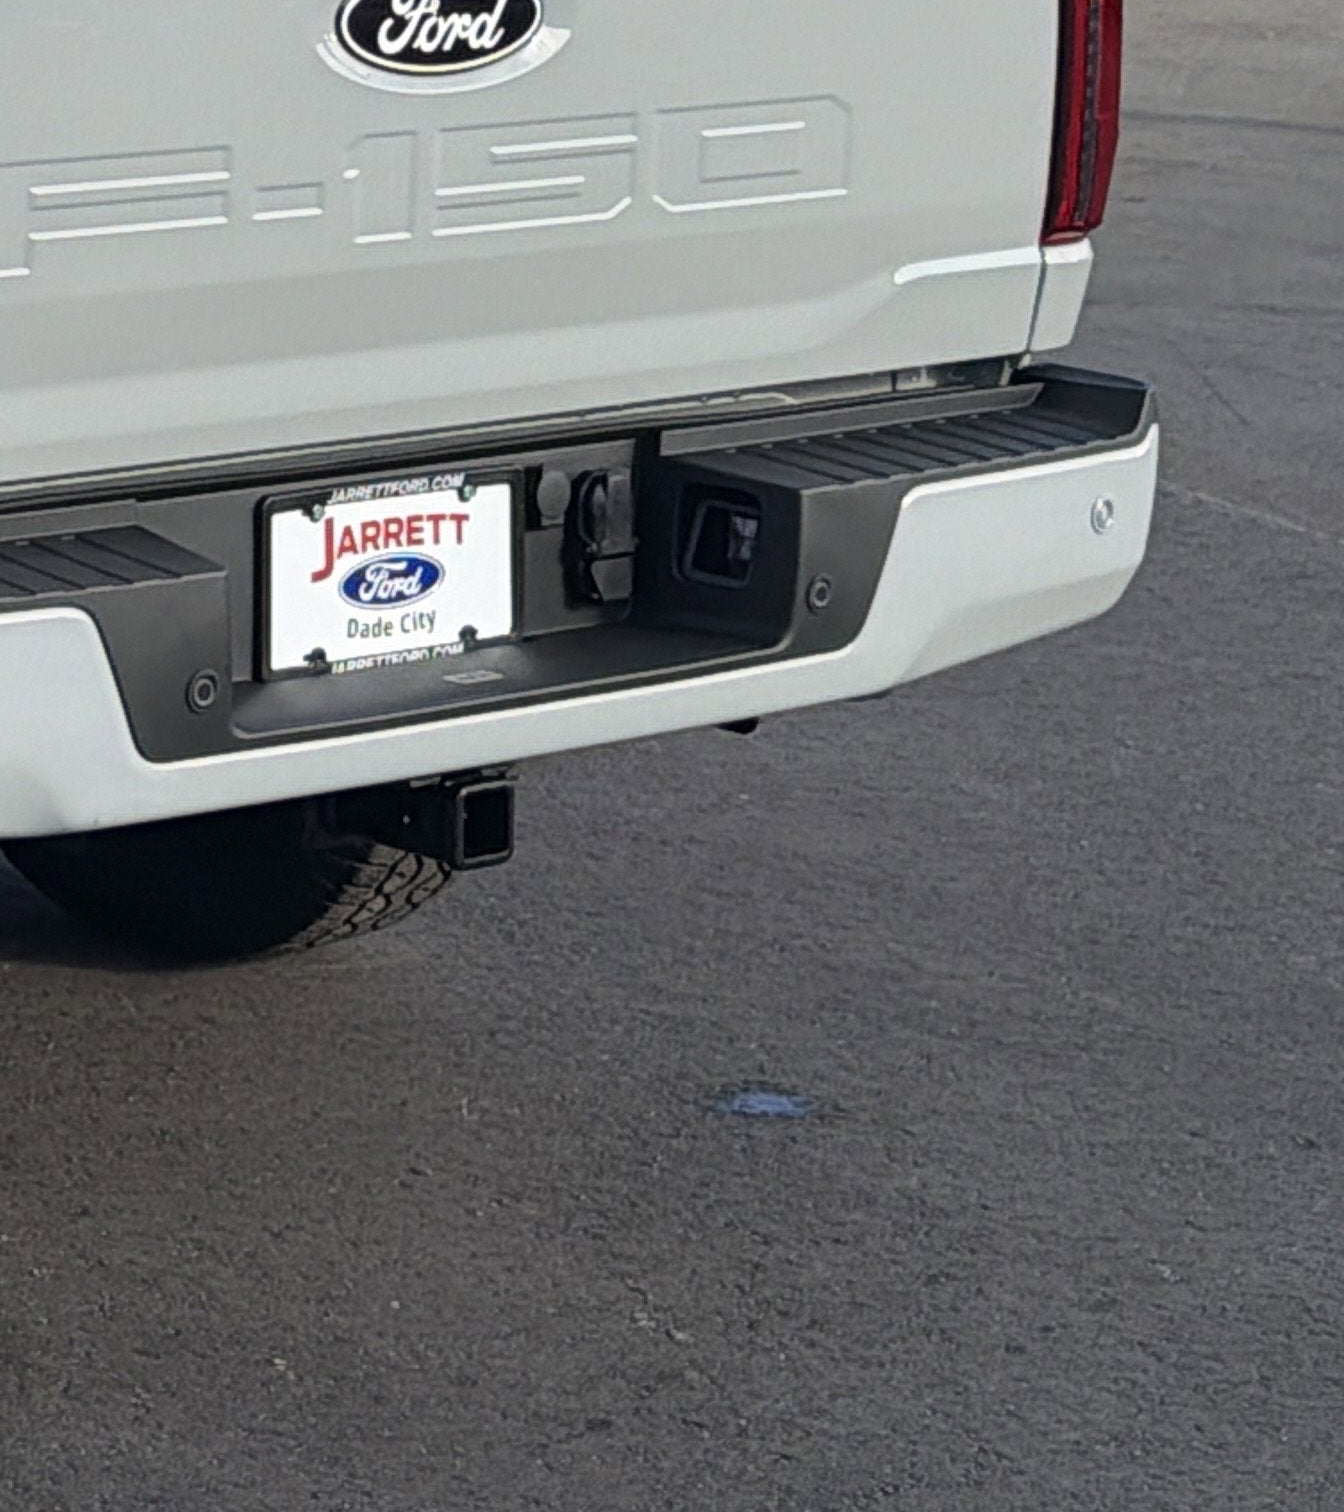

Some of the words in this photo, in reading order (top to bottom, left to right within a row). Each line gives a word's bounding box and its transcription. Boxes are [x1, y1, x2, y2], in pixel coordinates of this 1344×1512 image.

[310, 513, 470, 583] JARRETT
[358, 562, 423, 600] Ford
[347, 617, 393, 639] Dade
[400, 609, 436, 633] City
